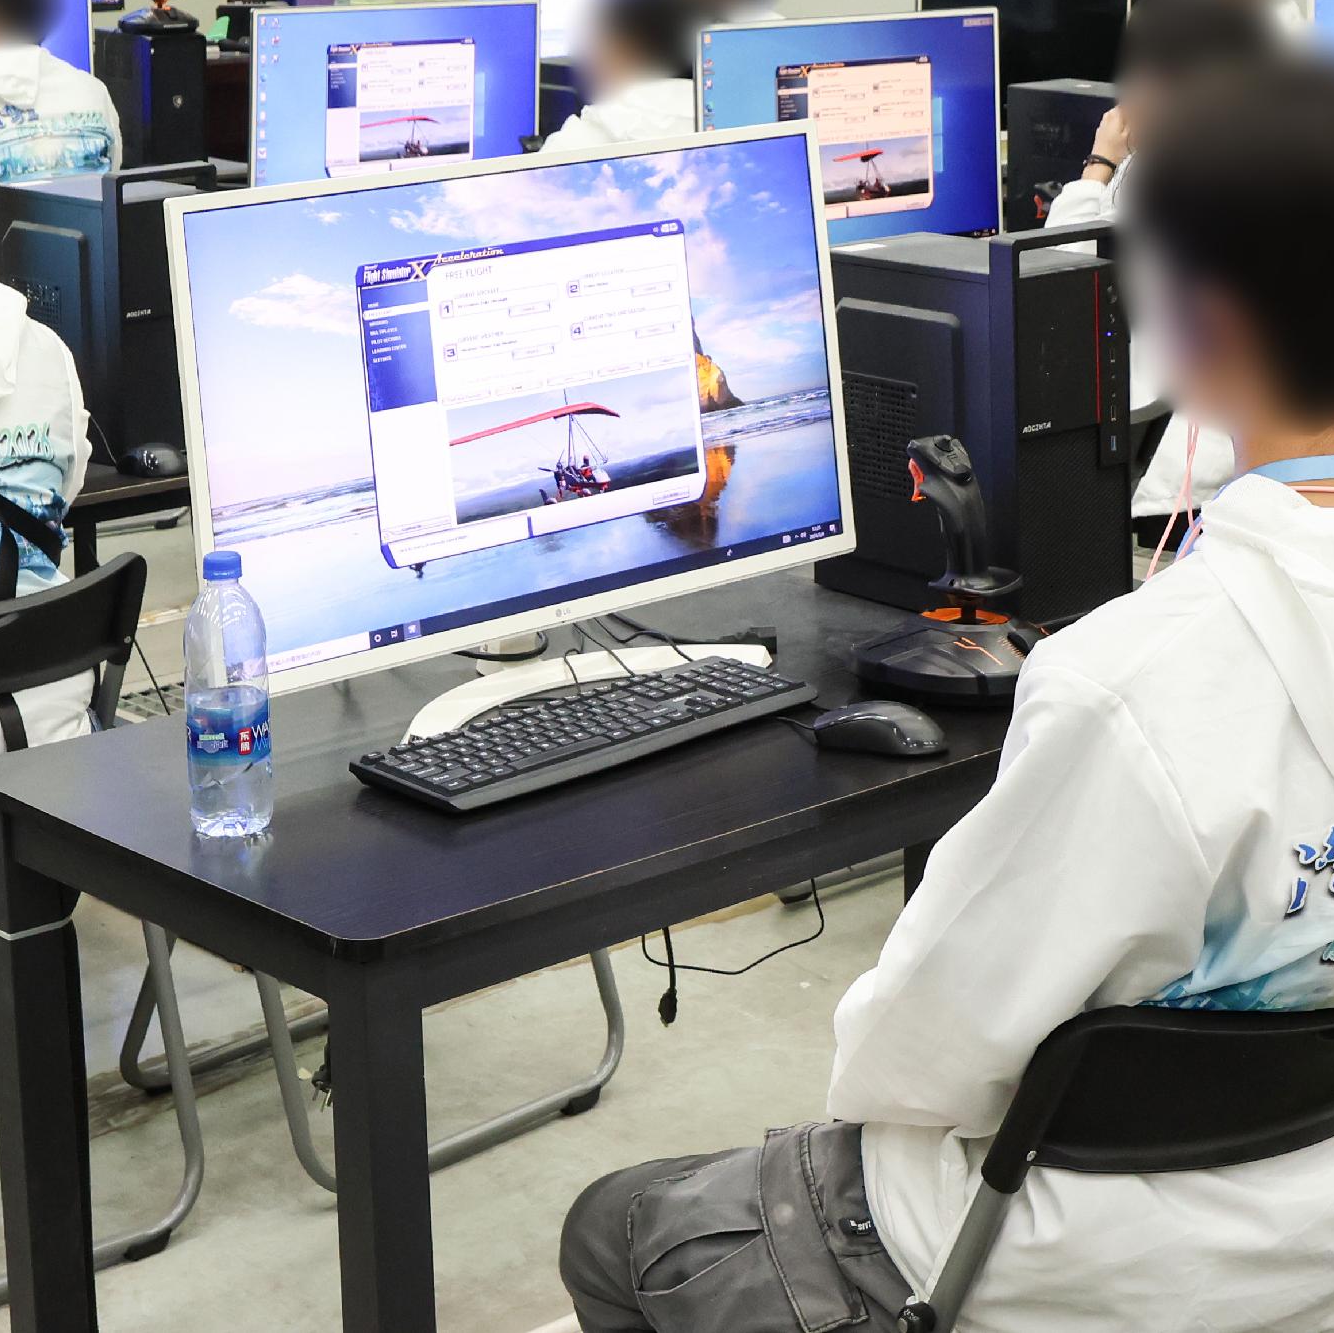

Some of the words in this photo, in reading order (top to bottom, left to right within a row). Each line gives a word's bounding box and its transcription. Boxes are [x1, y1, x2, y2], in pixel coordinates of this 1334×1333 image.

[433, 246, 504, 267] Acceleration
[363, 268, 381, 285] Flight
[381, 267, 412, 281] Simulator
[408, 261, 428, 281] X
[445, 270, 464, 280] FREE
[466, 265, 494, 278] FLIGHT
